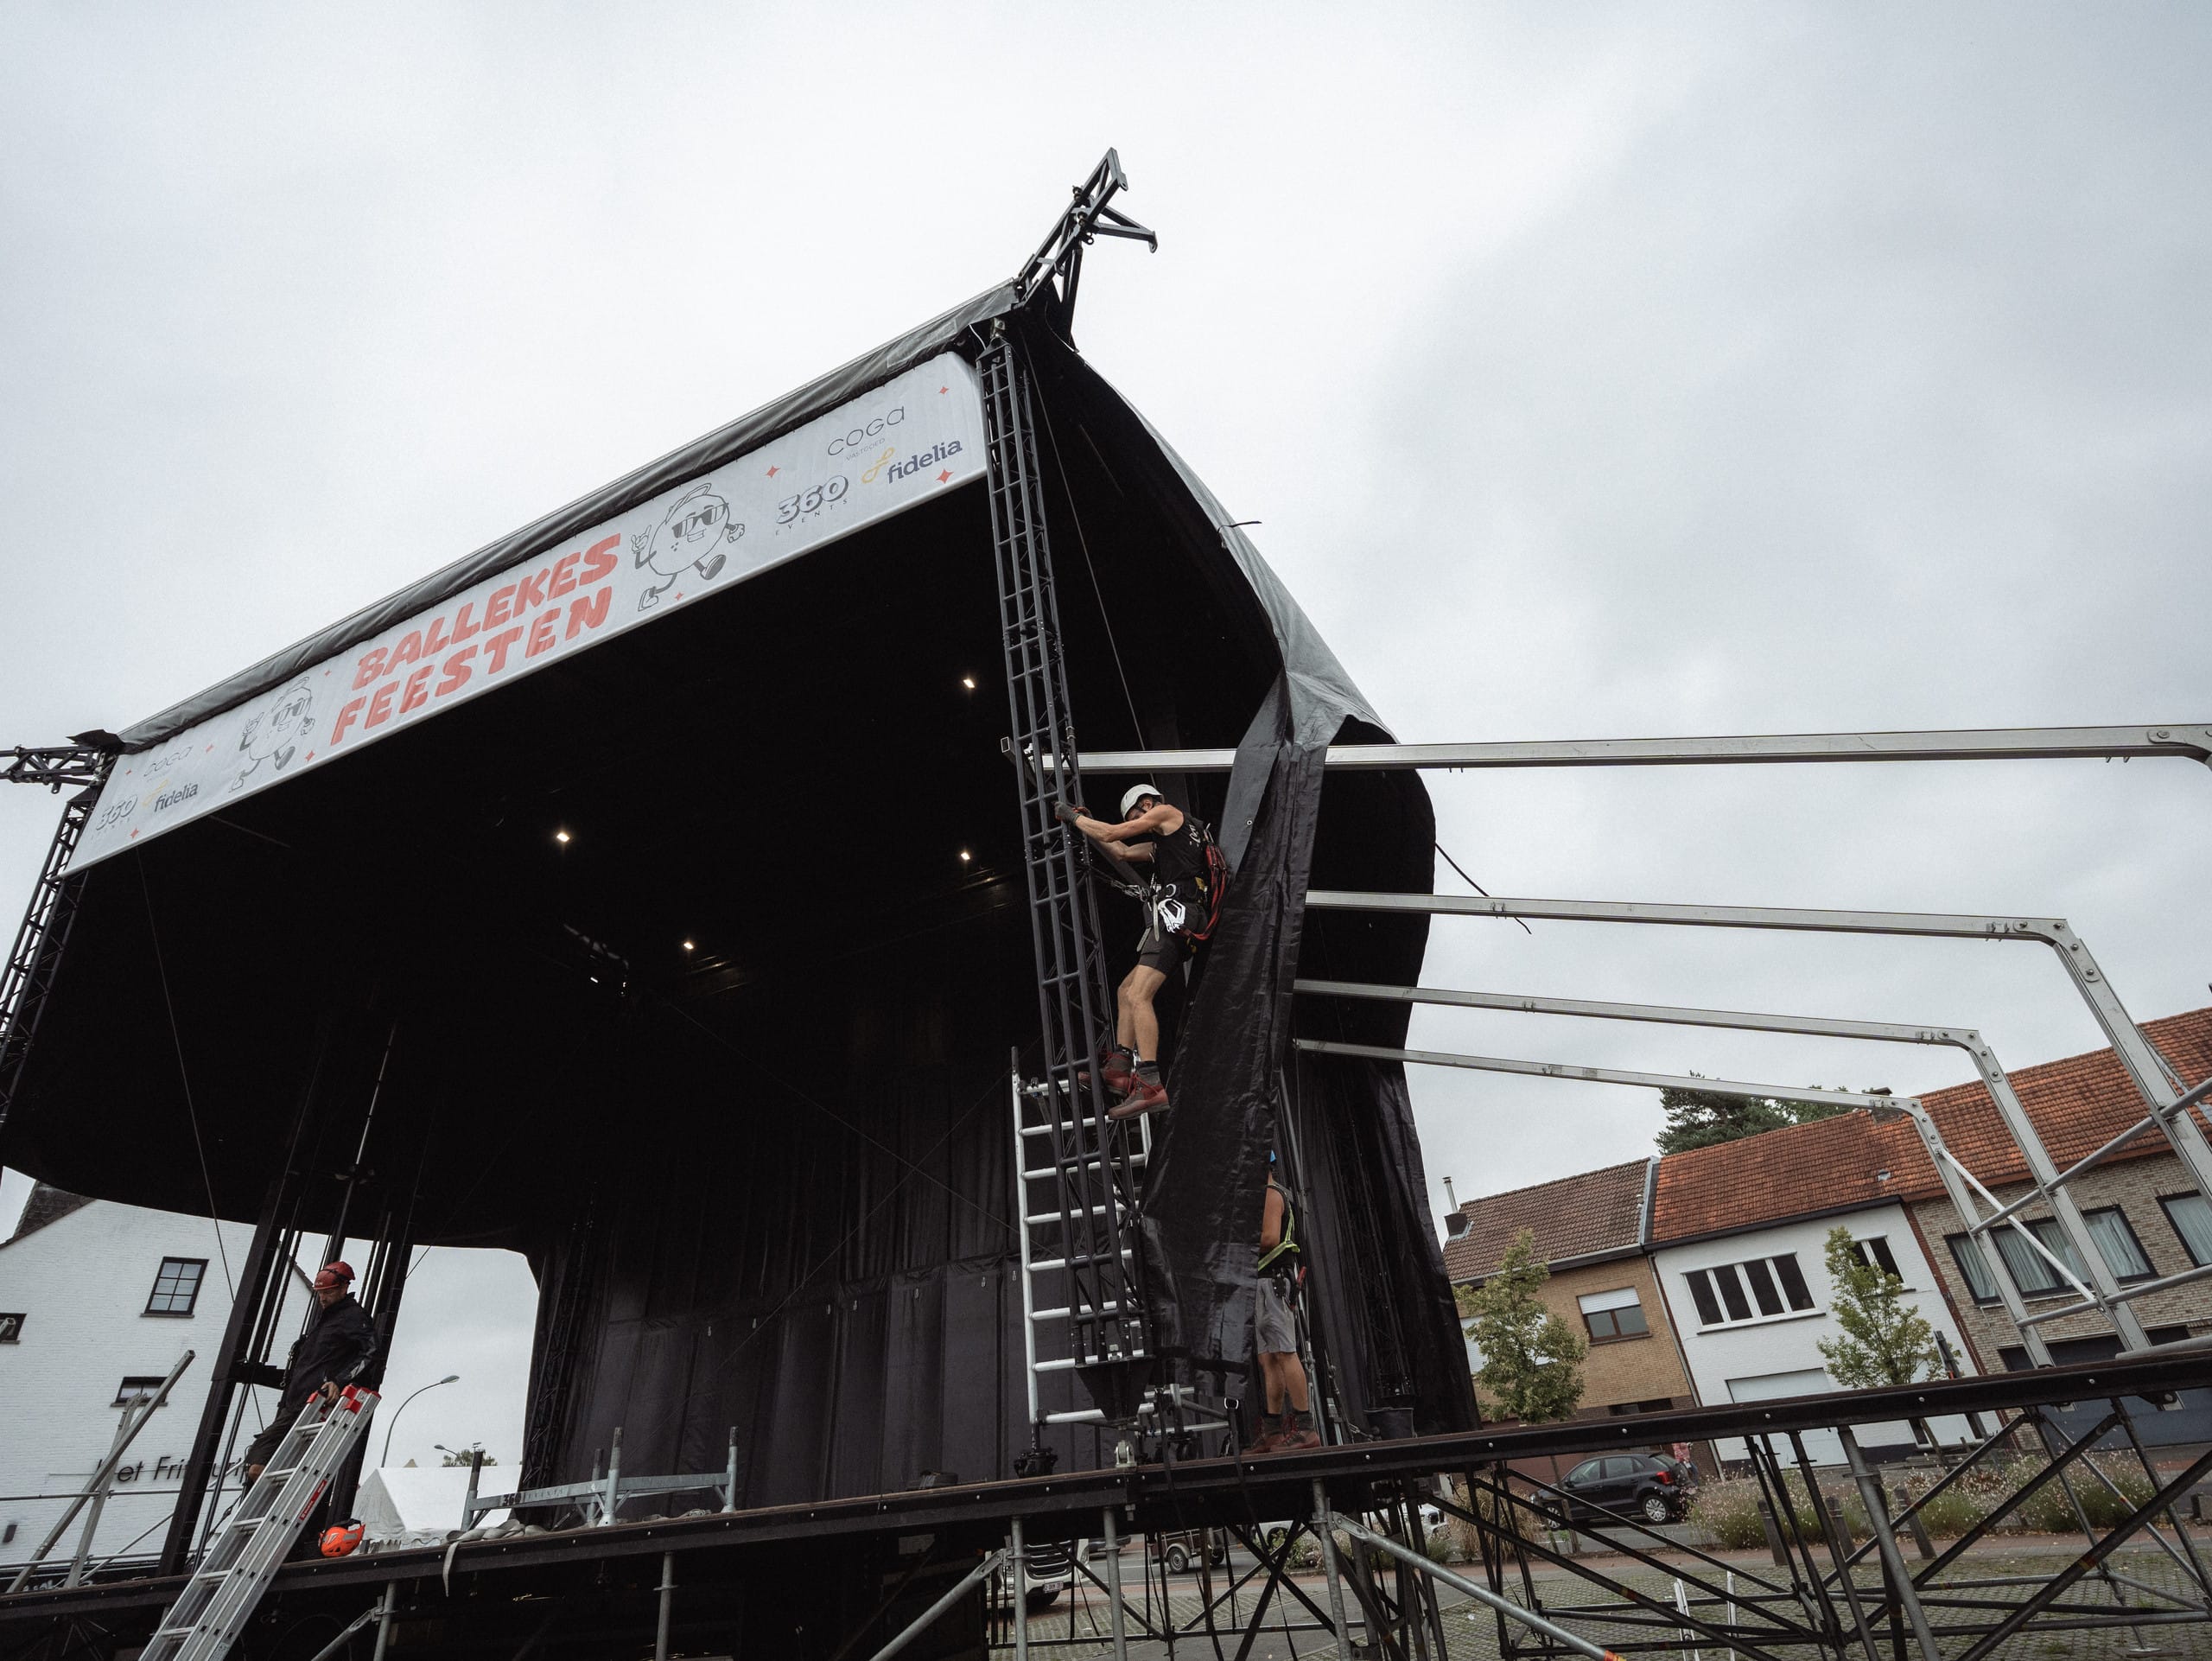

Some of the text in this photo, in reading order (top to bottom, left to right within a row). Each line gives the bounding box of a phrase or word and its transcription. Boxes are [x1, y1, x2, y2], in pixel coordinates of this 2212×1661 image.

[887, 440, 963, 484] fidelia
[776, 474, 849, 525] 360
[351, 532, 621, 690] BALLEKES
[330, 586, 613, 747] FEESTEN
[154, 782, 199, 813] fidelia
